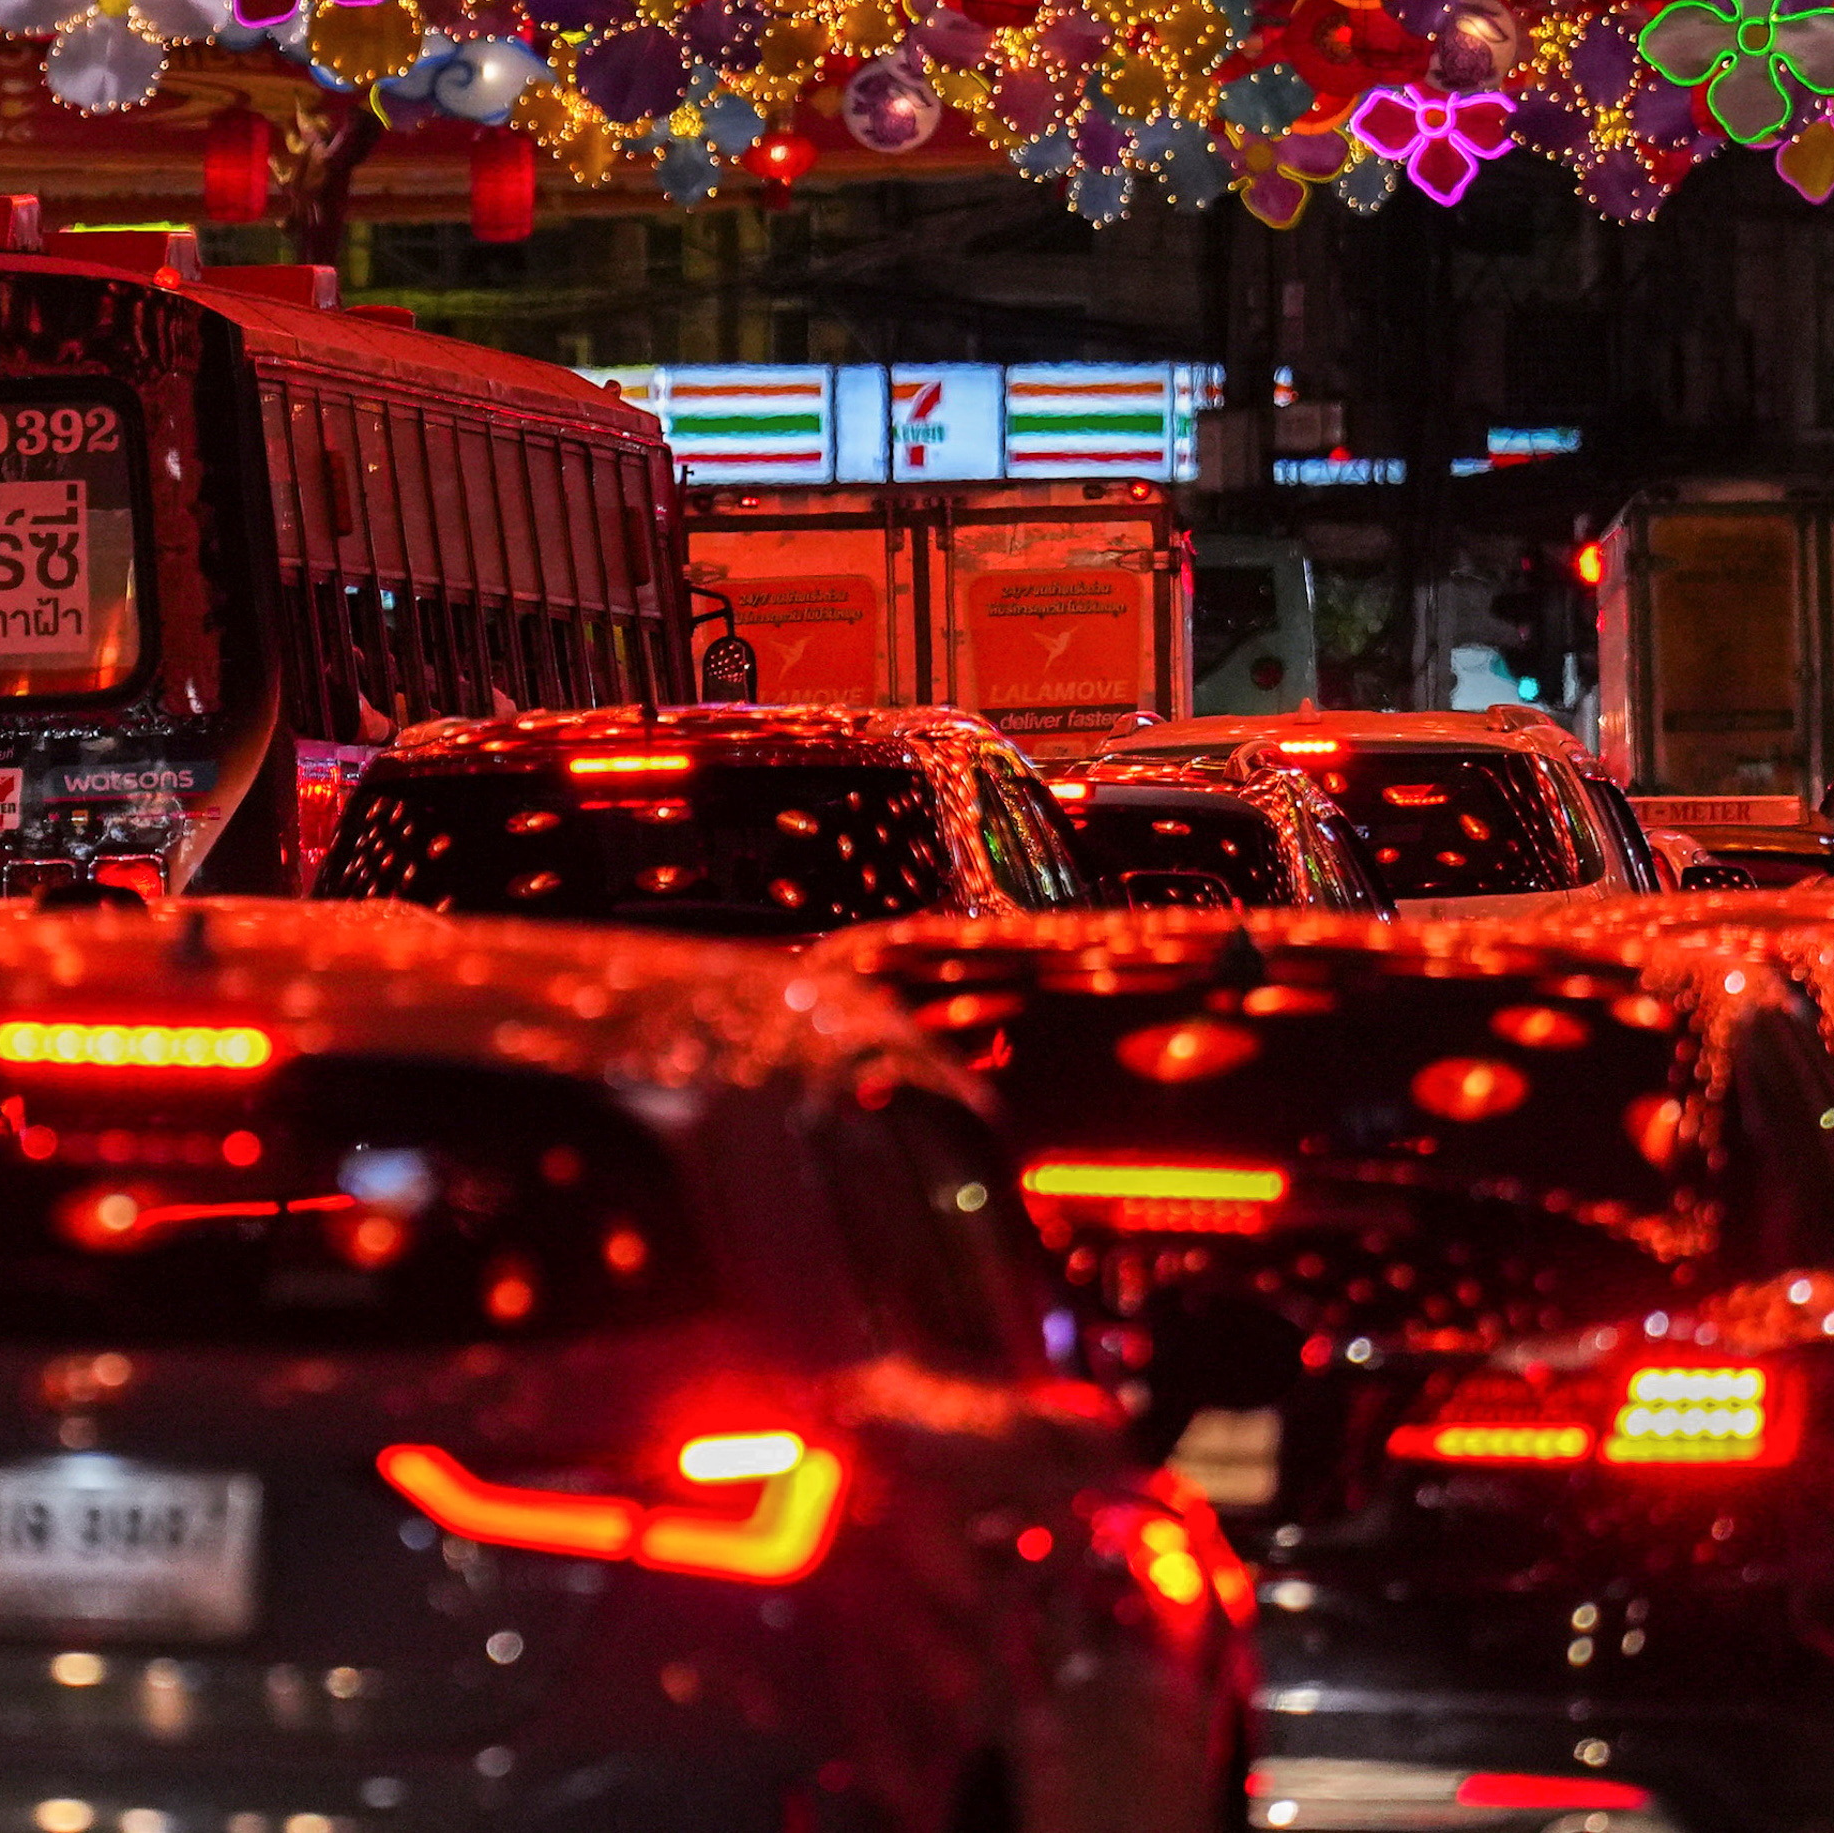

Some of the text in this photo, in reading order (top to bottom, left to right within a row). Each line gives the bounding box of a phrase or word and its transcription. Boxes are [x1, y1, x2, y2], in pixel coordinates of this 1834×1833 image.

[989, 680, 1128, 704] LALAMOVE
[999, 712, 1063, 731] deliver
[63, 769, 195, 794] watsons
